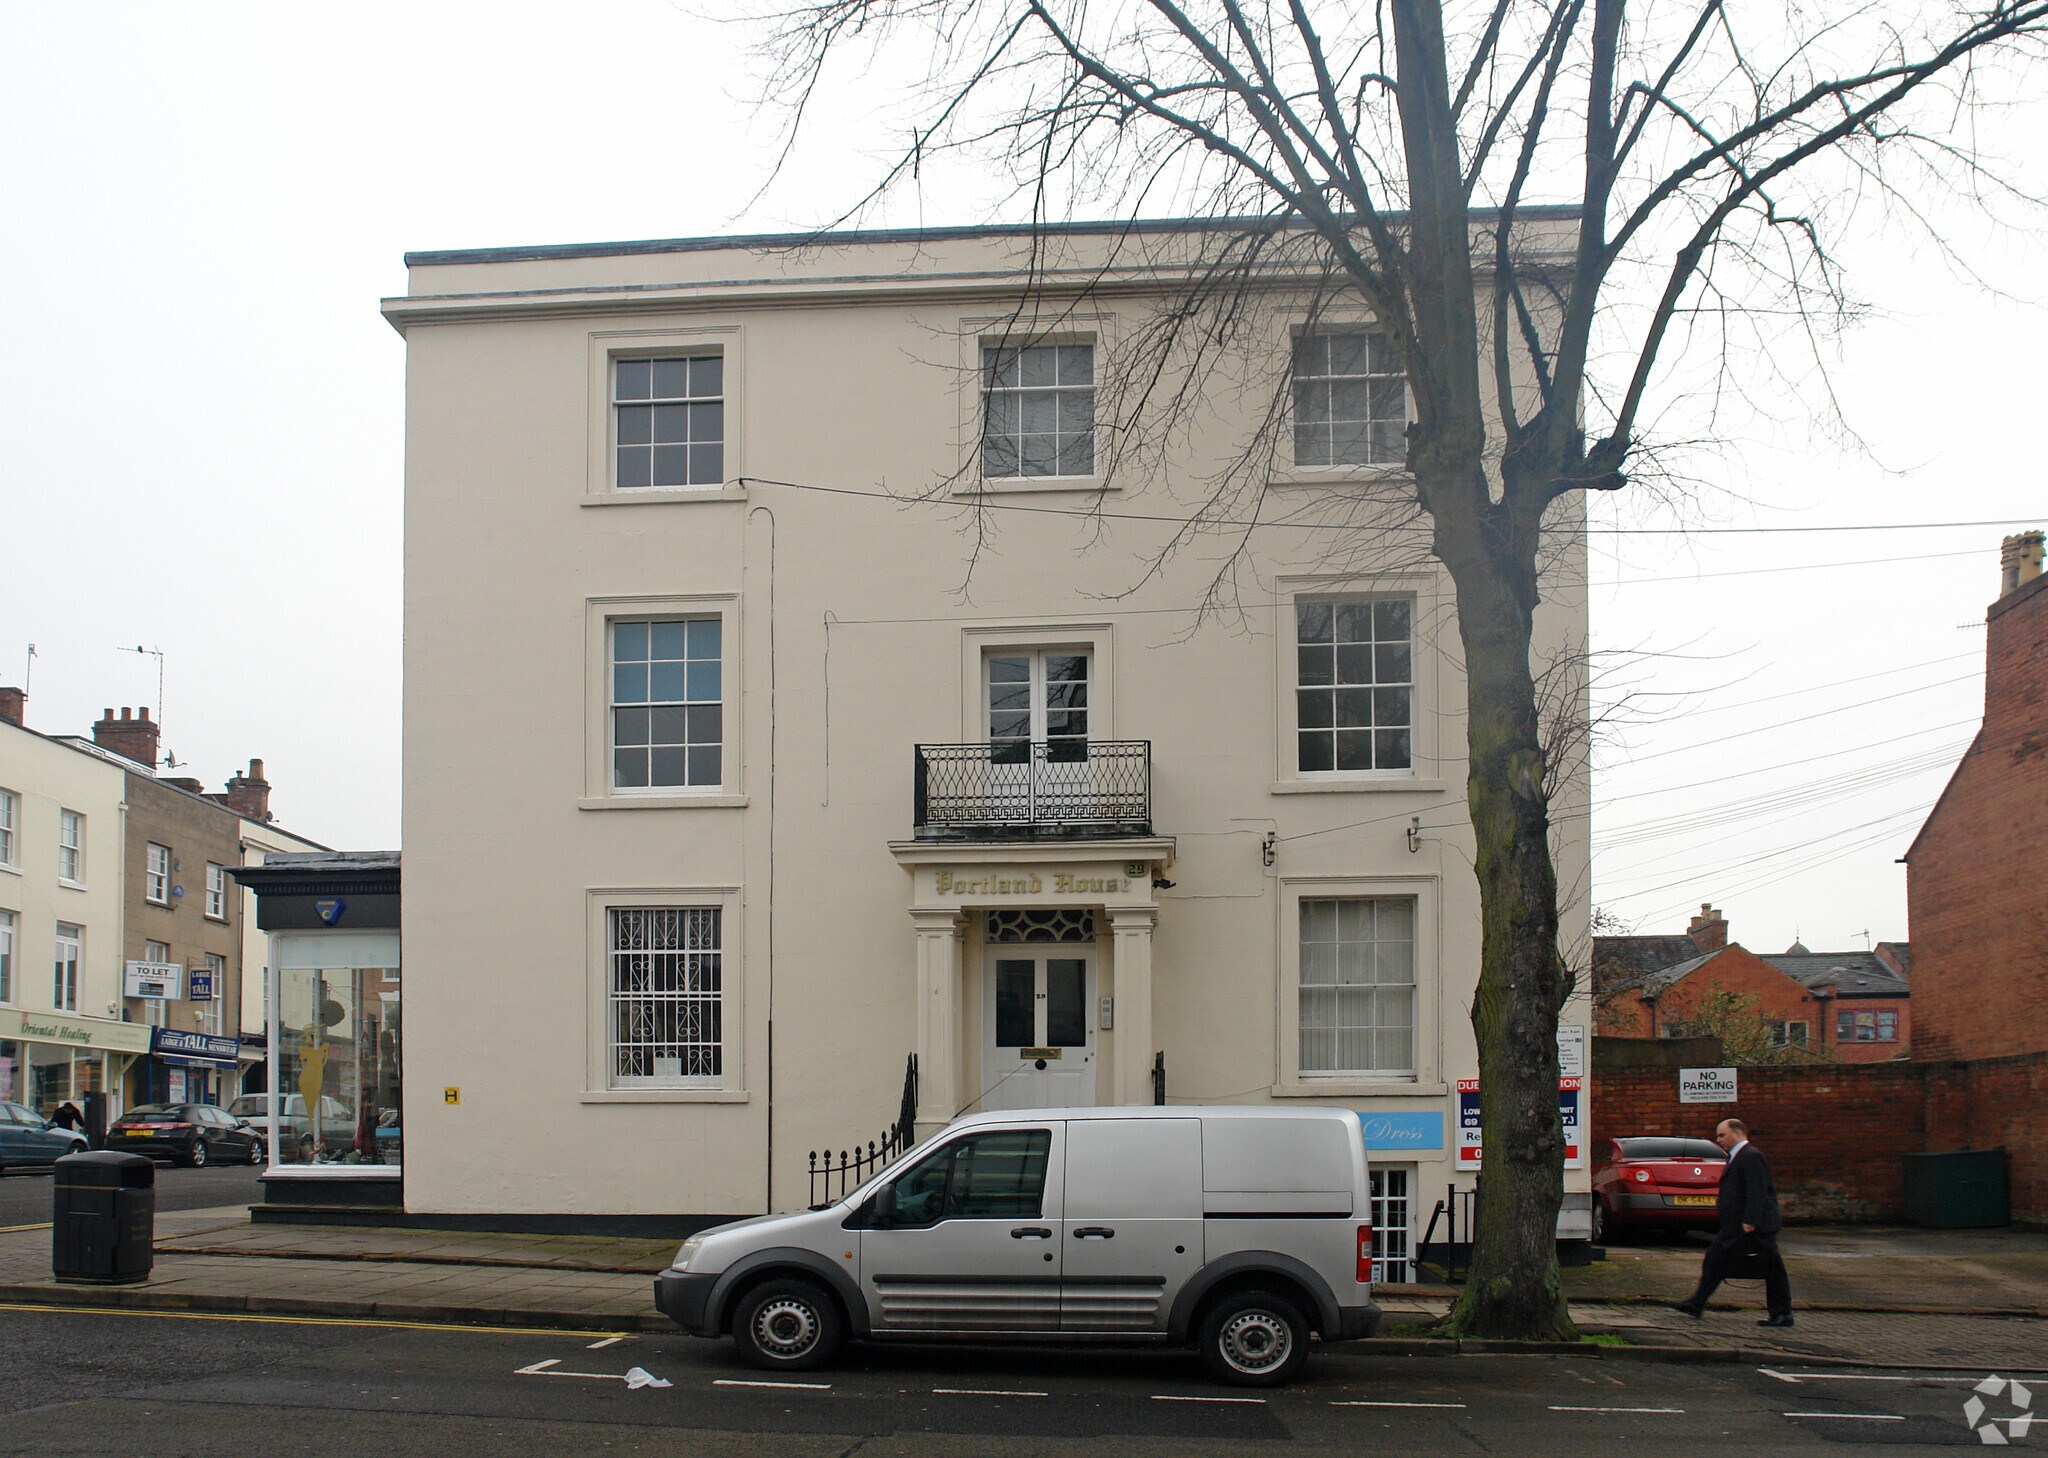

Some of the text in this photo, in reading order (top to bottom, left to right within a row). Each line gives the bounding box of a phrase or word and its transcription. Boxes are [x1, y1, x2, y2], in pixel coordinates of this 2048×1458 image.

[1128, 863, 1145, 875] 29
[935, 870, 1132, 896] Portland House
[136, 966, 170, 976] TO LET
[191, 984, 211, 994] TALL
[21, 1022, 58, 1037] Oriental
[58, 1026, 93, 1043] Healing
[160, 1037, 179, 1047] LARGE
[183, 1034, 208, 1051] TALL
[208, 1043, 238, 1054] MENSWEAR
[1699, 1071, 1718, 1081] NO
[1457, 1081, 1480, 1090] DUE
[1683, 1081, 1735, 1090] PARKING
[444, 1090, 458, 1102] H
[1363, 1117, 1424, 1140] Dress
